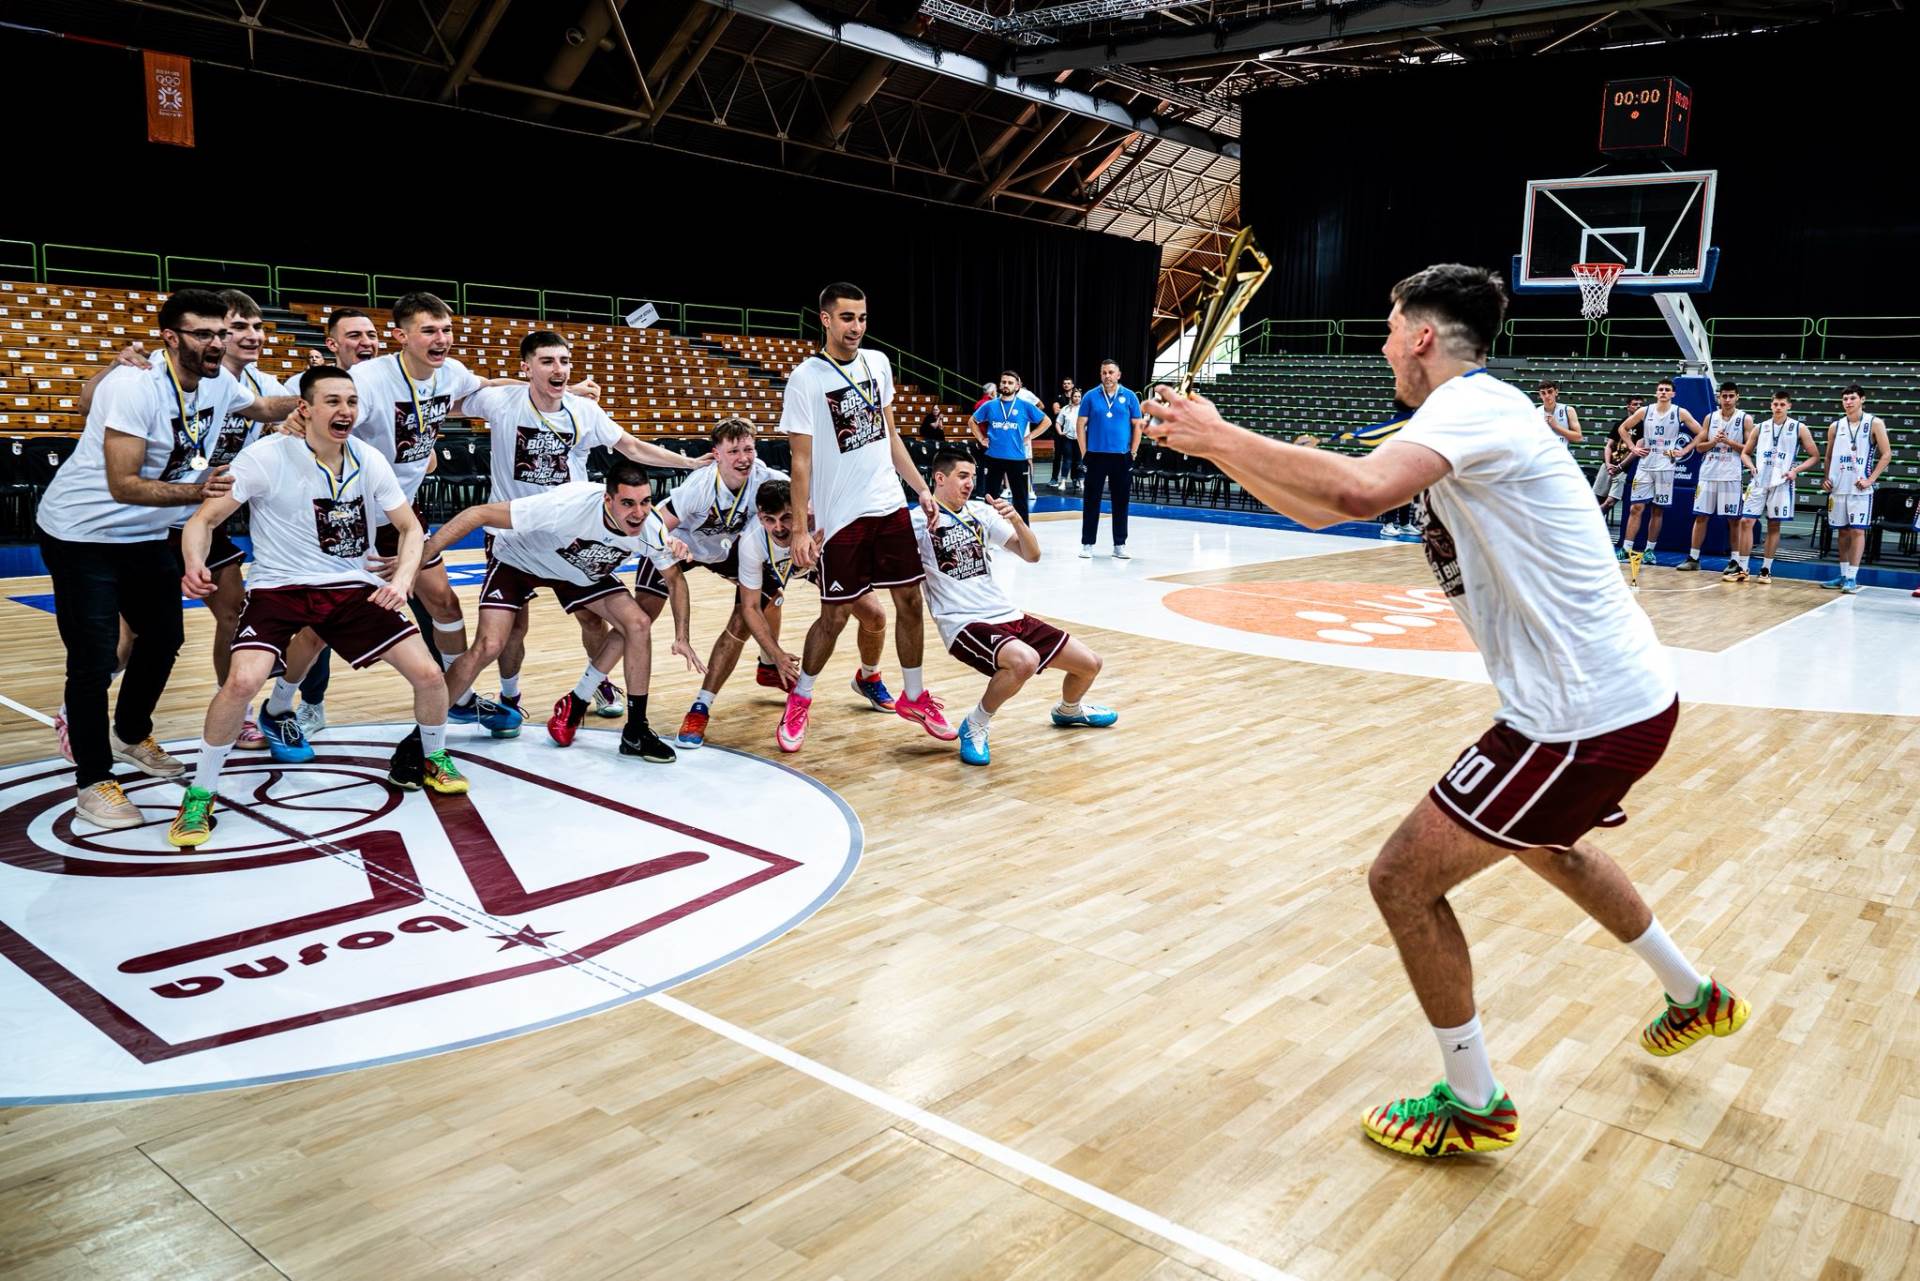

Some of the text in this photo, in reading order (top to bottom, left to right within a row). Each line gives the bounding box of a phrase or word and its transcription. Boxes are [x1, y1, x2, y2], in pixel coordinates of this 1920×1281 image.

[1614, 89, 1660, 106] 00:00
[1654, 426, 1665, 435] 33
[1659, 494, 1669, 504] 33
[1782, 506, 1788, 517] 6
[1859, 513, 1866, 524] 7
[150, 914, 470, 999] bosna
